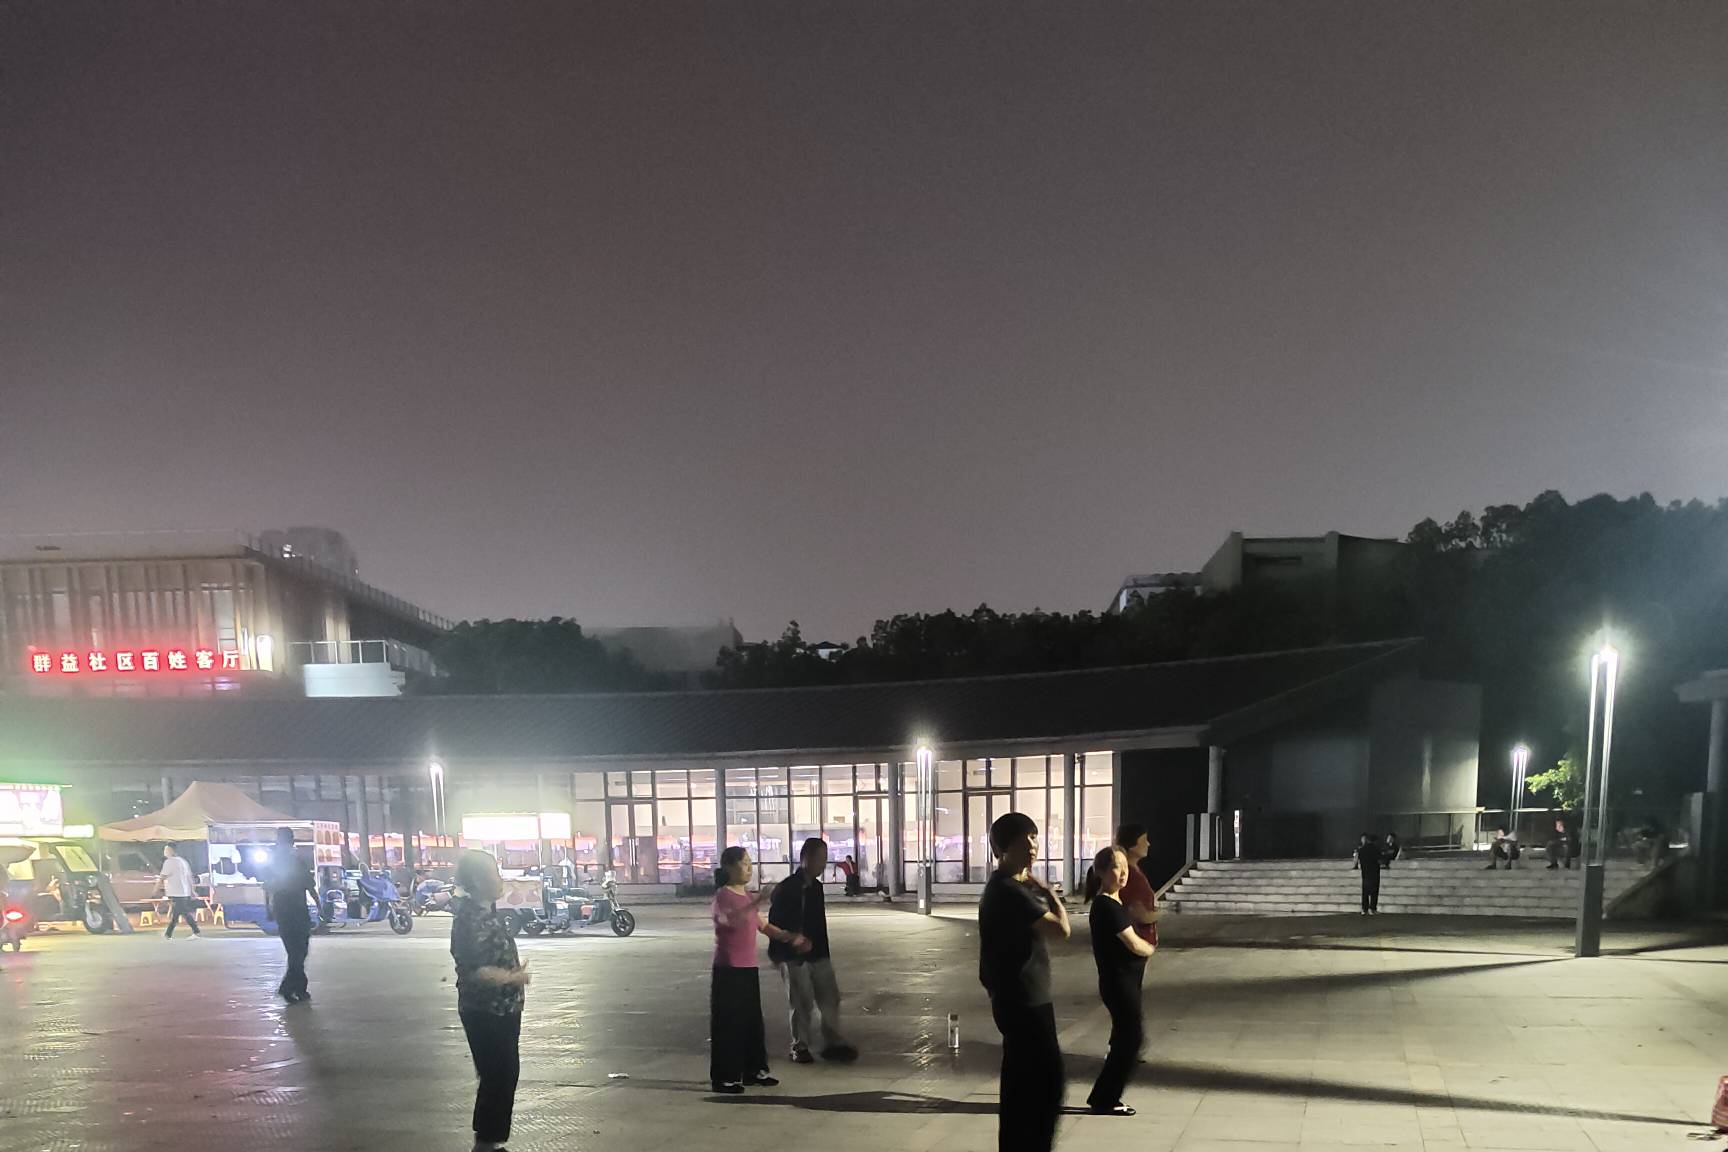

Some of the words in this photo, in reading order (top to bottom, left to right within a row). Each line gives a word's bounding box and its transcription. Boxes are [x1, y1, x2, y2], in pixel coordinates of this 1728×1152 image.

[32, 650, 240, 673] 群益社区百姓客厅
